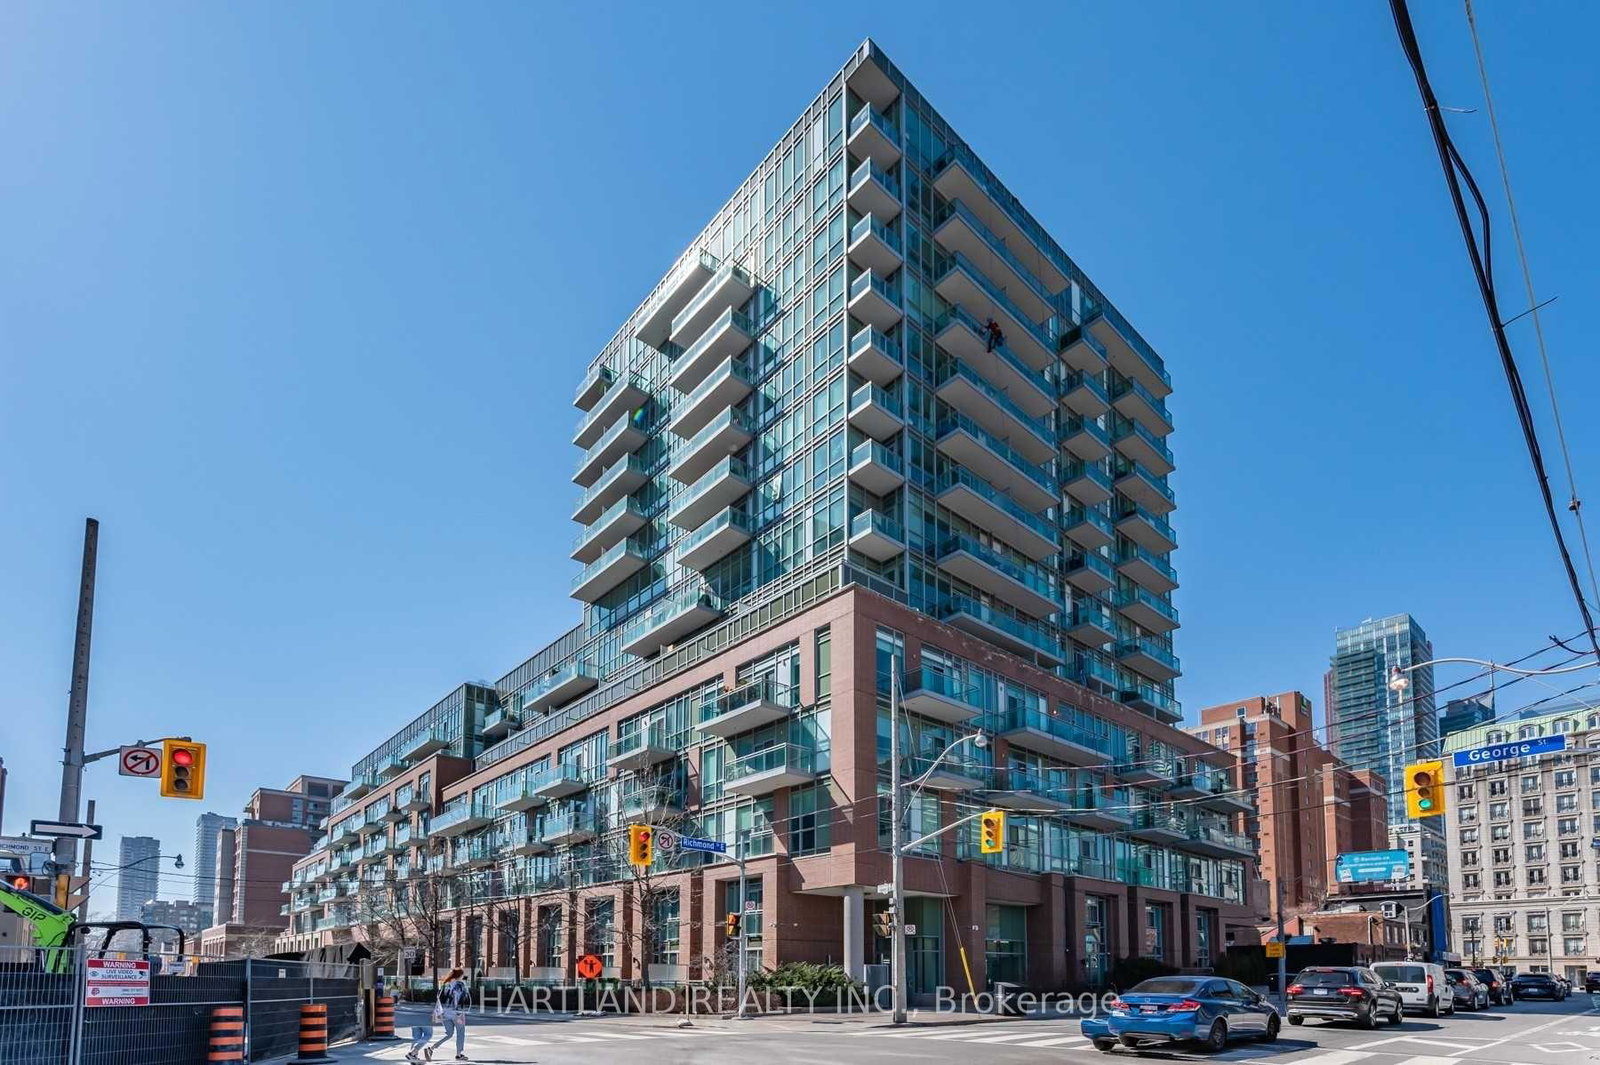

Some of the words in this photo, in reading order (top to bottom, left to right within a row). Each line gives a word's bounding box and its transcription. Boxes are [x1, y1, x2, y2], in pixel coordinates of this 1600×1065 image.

[1469, 744, 1530, 760] George
[684, 838, 714, 850] Richmond
[22, 907, 46, 920] GIP
[103, 961, 137, 969] WARNING
[102, 997, 136, 1005] WARNING
